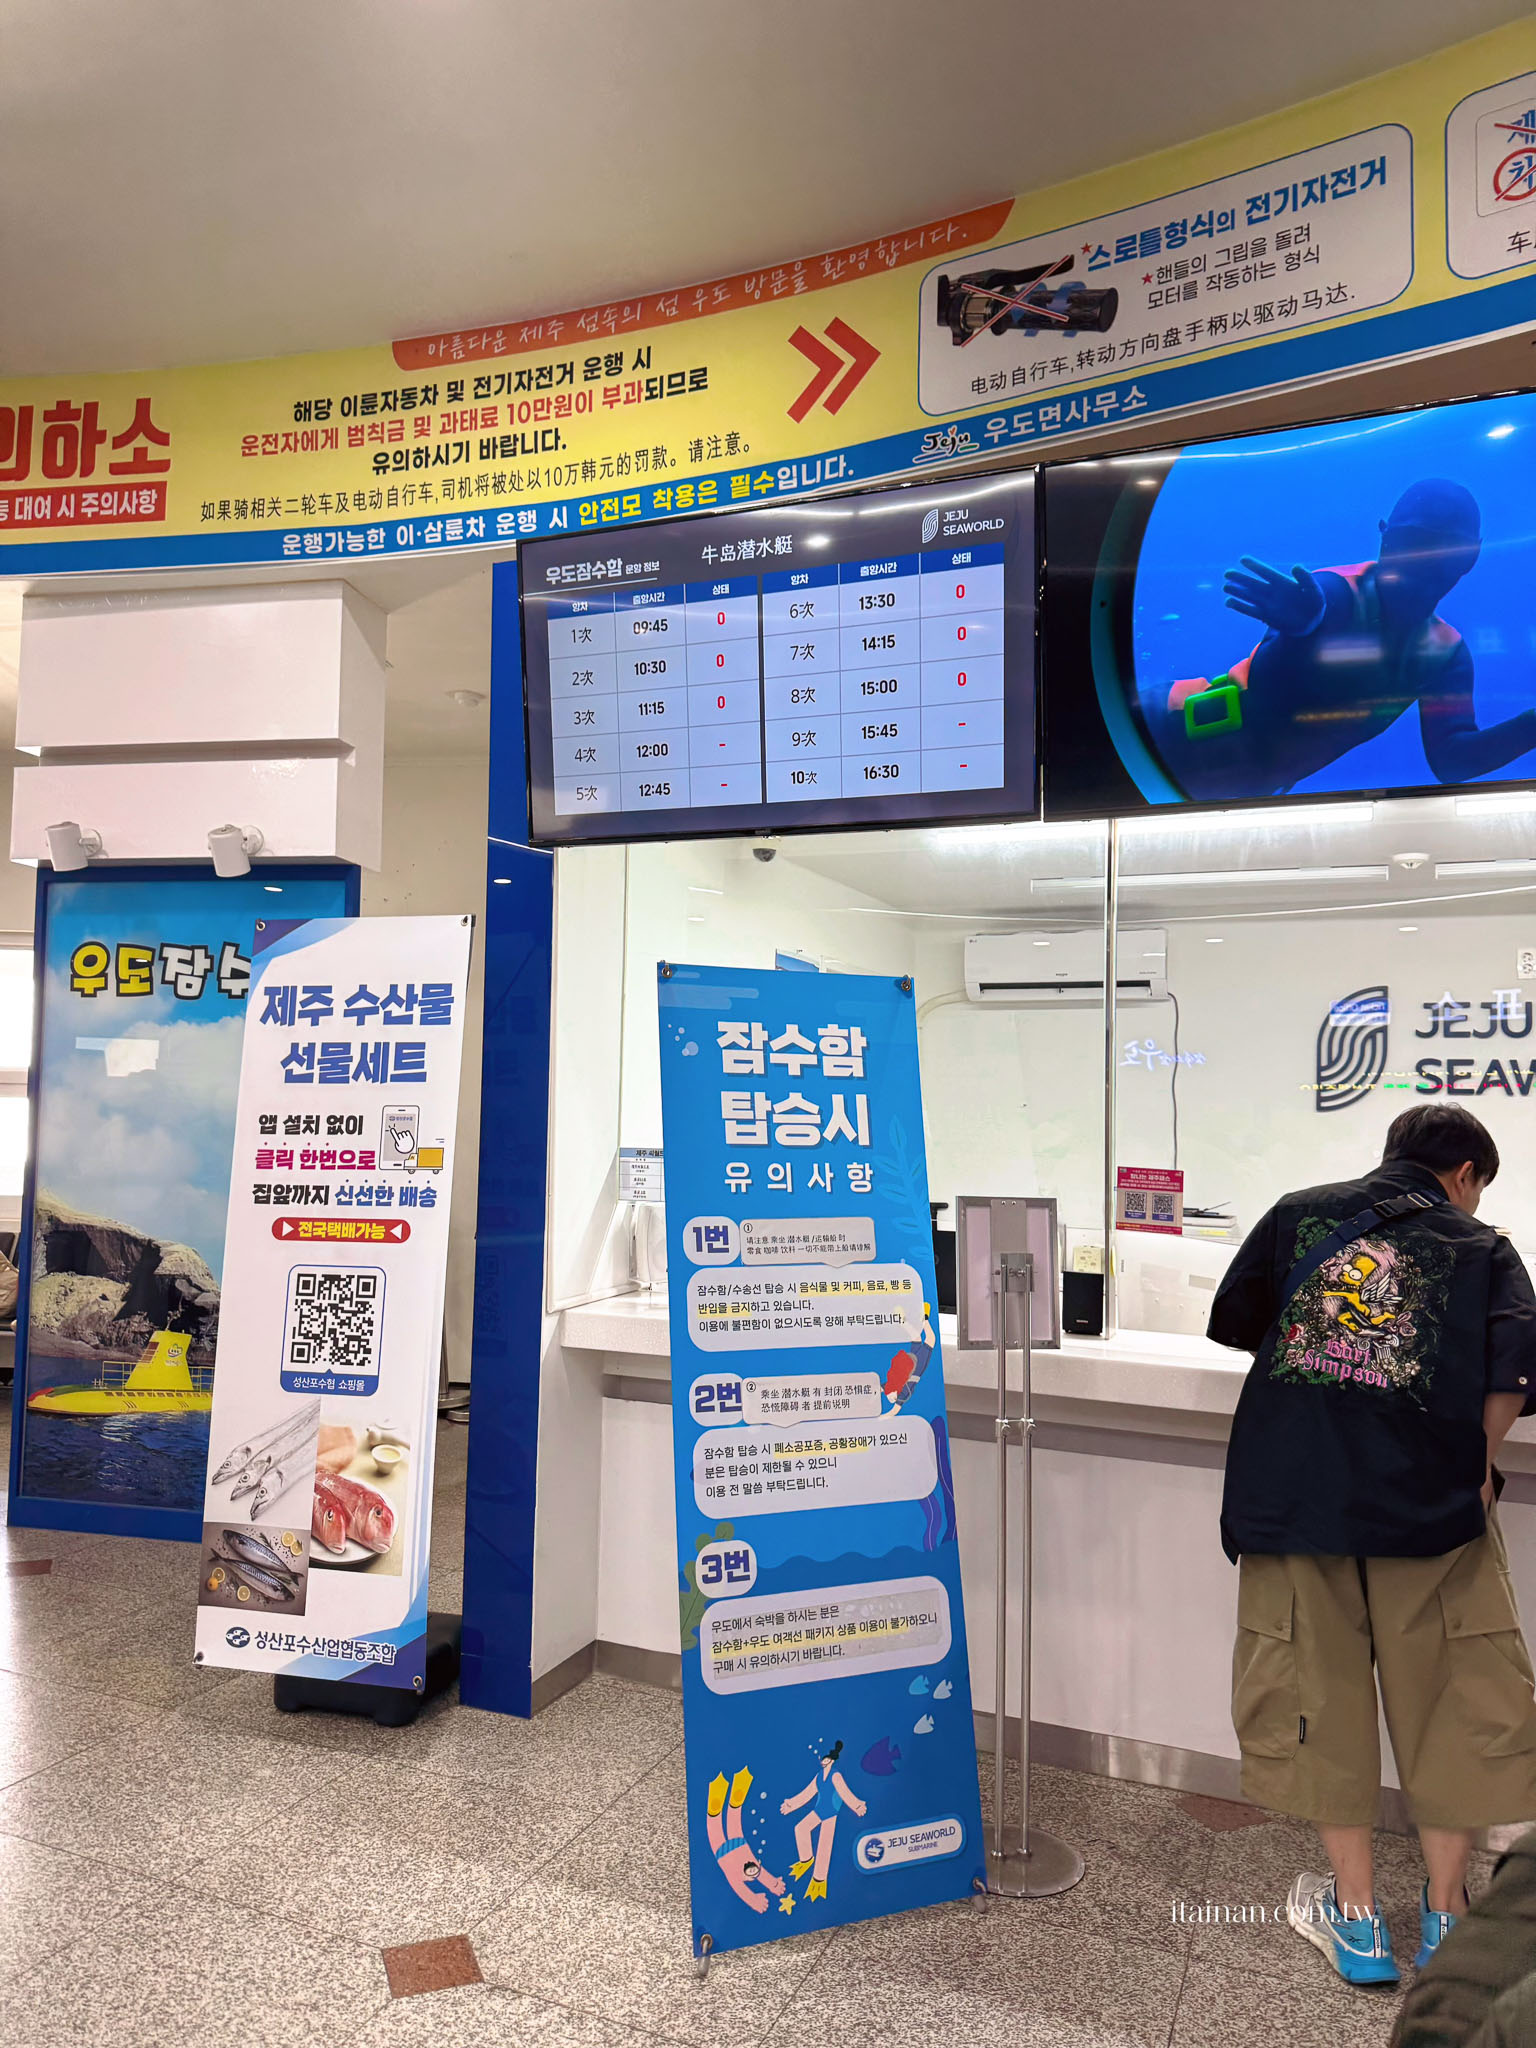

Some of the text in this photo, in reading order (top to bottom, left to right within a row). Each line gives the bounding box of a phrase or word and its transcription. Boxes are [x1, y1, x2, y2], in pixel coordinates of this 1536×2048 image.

[1088, 156, 1387, 273] 스로틀형식의 전기자전거
[1156, 224, 1312, 285] 핸들의 그립을 돌려
[1147, 245, 1321, 309] 모터를 작동하는 형식
[427, 223, 967, 361] 아름다운 제주 섬속의 섬 우도 방문을 환영합니다.
[293, 346, 652, 422] 해당 이륜자동차 및 전기자전거 운행 시
[240, 367, 709, 457] 운전자에게 범칙금 및 과태료 10만원이 부과되므로
[983, 385, 1148, 443] 우도면사무소
[372, 428, 567, 475] 유의하시기 바랍니다.
[15, 495, 51, 520] 대여
[57, 493, 75, 518] 시
[81, 488, 158, 518] 주의사항
[282, 455, 854, 555] 운행가능한 이·삼륜차 운행 시 안전모 착용은 필수입니다.
[943, 509, 969, 522] JEJU
[943, 518, 1005, 536] SEAWORLD
[701, 534, 793, 565] 牛岛潜水艇
[952, 552, 971, 564] 상태
[546, 558, 622, 585] 우도잠수함
[644, 560, 660, 572] 정보
[712, 584, 730, 596] 상태
[790, 601, 815, 619] 6次
[859, 593, 896, 610] 13:30
[571, 627, 592, 644] 1次
[633, 619, 668, 635] 09:45
[790, 643, 815, 661] 7次
[862, 634, 896, 651] 14:15
[572, 670, 593, 687] 2次
[634, 660, 667, 676] 10:30
[791, 686, 816, 704] 8次
[860, 679, 898, 695] 15:00
[574, 709, 595, 725] 3次
[638, 701, 665, 716] 11:15
[792, 730, 817, 747] 9次
[861, 723, 898, 740] 15:45
[574, 747, 597, 763] 4次
[636, 743, 669, 758] 12:00
[790, 771, 817, 785] 10次
[863, 764, 899, 780] 16:30
[576, 785, 598, 801] 5次
[639, 783, 671, 798] 12:45
[260, 982, 454, 1027] 제주 수산물
[1415, 1001, 1533, 1039] JEJU
[716, 1021, 867, 1077] 잠수함
[280, 1041, 427, 1085] 선물세트
[259, 1115, 364, 1136] 앱 설치 없이
[721, 1091, 870, 1146] 탑승시
[255, 1149, 376, 1171] 클릭 한번으로
[252, 1183, 437, 1208] 집앞까지 신선한 배송
[298, 1221, 386, 1240] 전국택배가능
[692, 1225, 729, 1253] 1번
[697, 1279, 912, 1297] 잠수함/수송선 탑승 시 음식물 및 커피, 음료, 빵 등
[698, 1299, 814, 1315] 반입을 금지하고 있습니다.
[699, 1314, 905, 1333] 이용에 불편함이 없으시도록 양해 부탁드립니다.
[1325, 1340, 1371, 1364] Bart
[1303, 1349, 1388, 1388] Simpson
[292, 1375, 365, 1393] 성산포수협 쇼핑몰
[695, 1382, 742, 1413] 2번
[704, 1446, 734, 1460] 잠수함
[738, 1445, 758, 1458] 탑승
[761, 1443, 771, 1455] 시
[828, 1435, 877, 1450] 공황장애가
[879, 1433, 908, 1446] 있으신
[704, 1456, 837, 1478] 분은 탑승이 제한될 수 있으니
[706, 1476, 828, 1498] 이용 전 말씀 부탁드립니다.
[702, 1550, 750, 1584] 3번
[712, 1606, 840, 1632] 우도에서 숙박을 하시는 분은
[712, 1612, 938, 1654] 잠수함+우도 여객선 패키지 상품 이용이 불가하오니
[254, 1630, 396, 1664] 성산포수산업협동조합
[714, 1645, 846, 1674] 구매 시 유의하시기 바랍니다.
[888, 1826, 956, 1848] JEJU SEAWORLD
